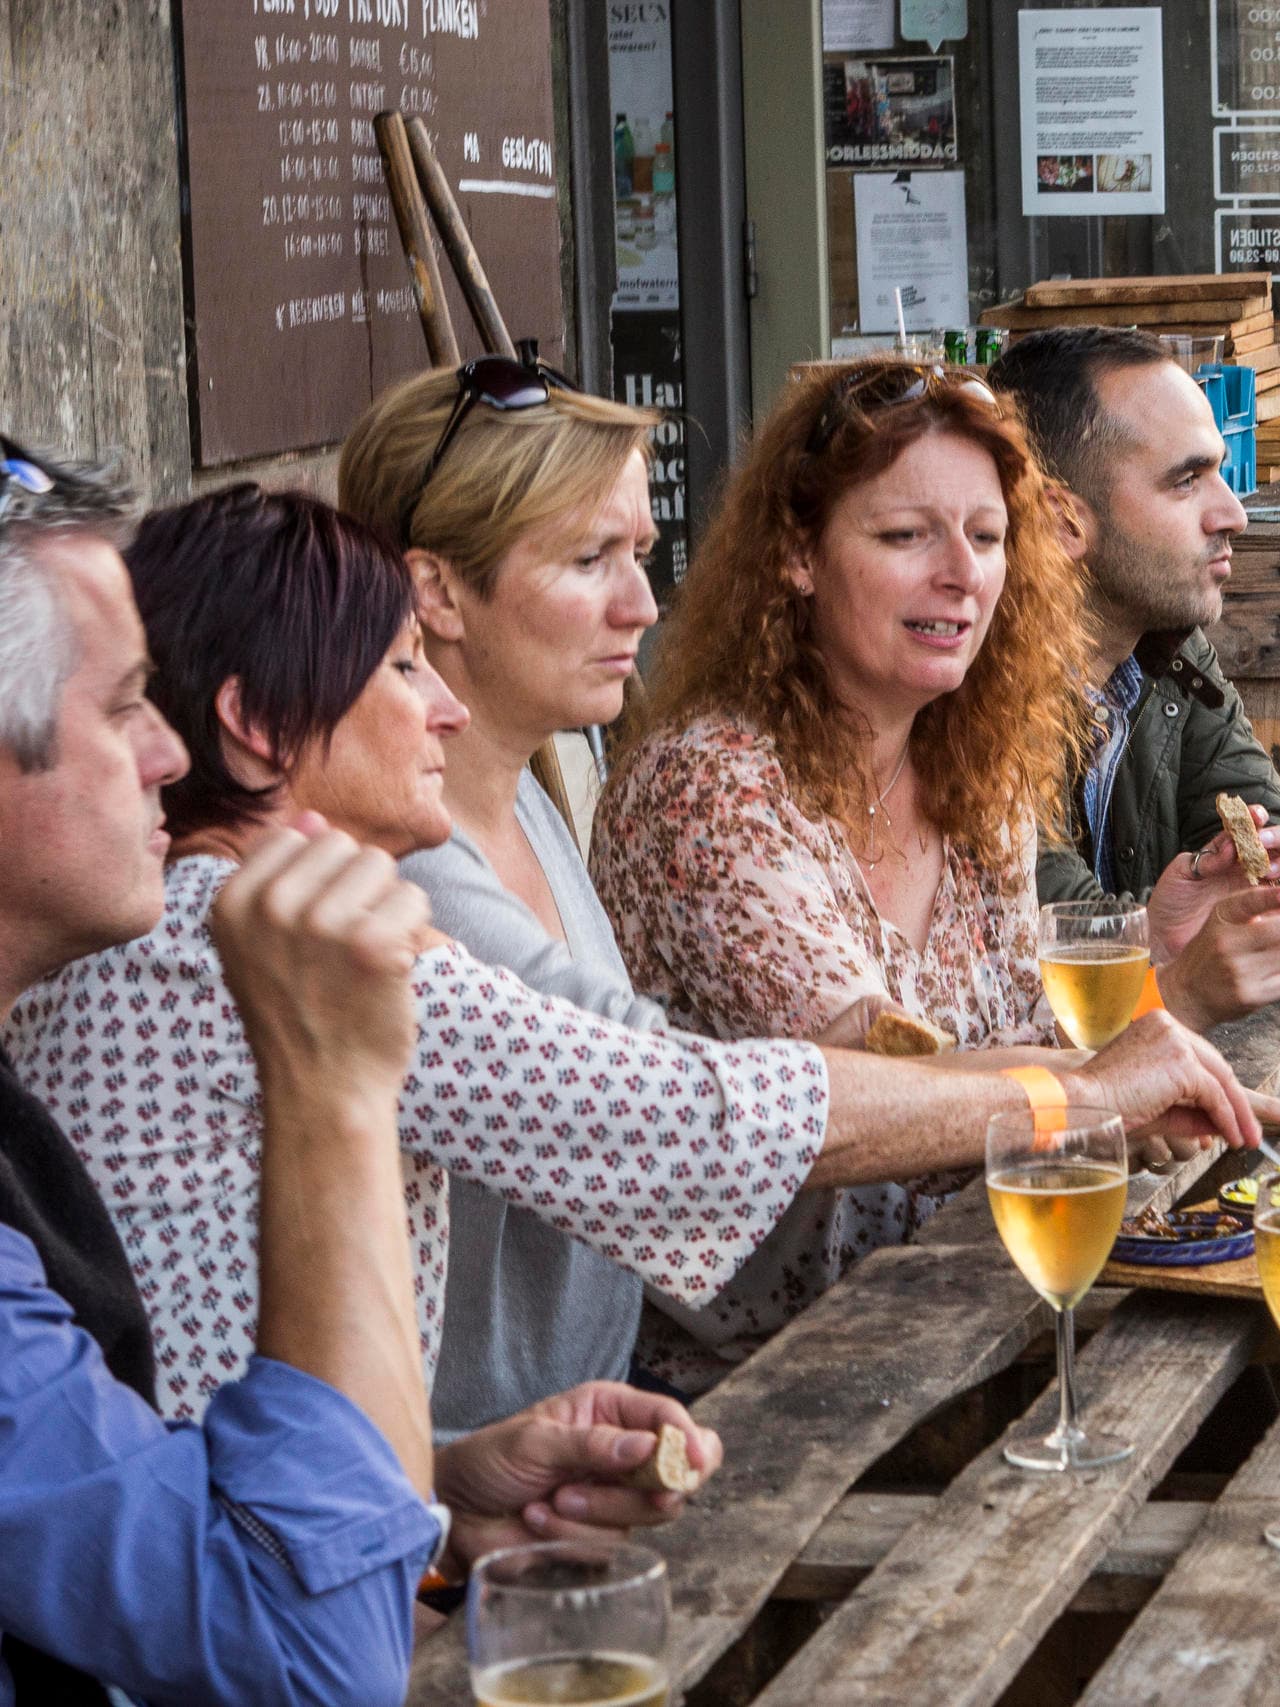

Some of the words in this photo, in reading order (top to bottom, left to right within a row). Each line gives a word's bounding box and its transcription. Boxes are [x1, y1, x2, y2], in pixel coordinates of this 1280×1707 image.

[421, 0, 480, 41] PLANKEN
[463, 132, 480, 164] MA
[502, 135, 553, 180] GESLOTEN
